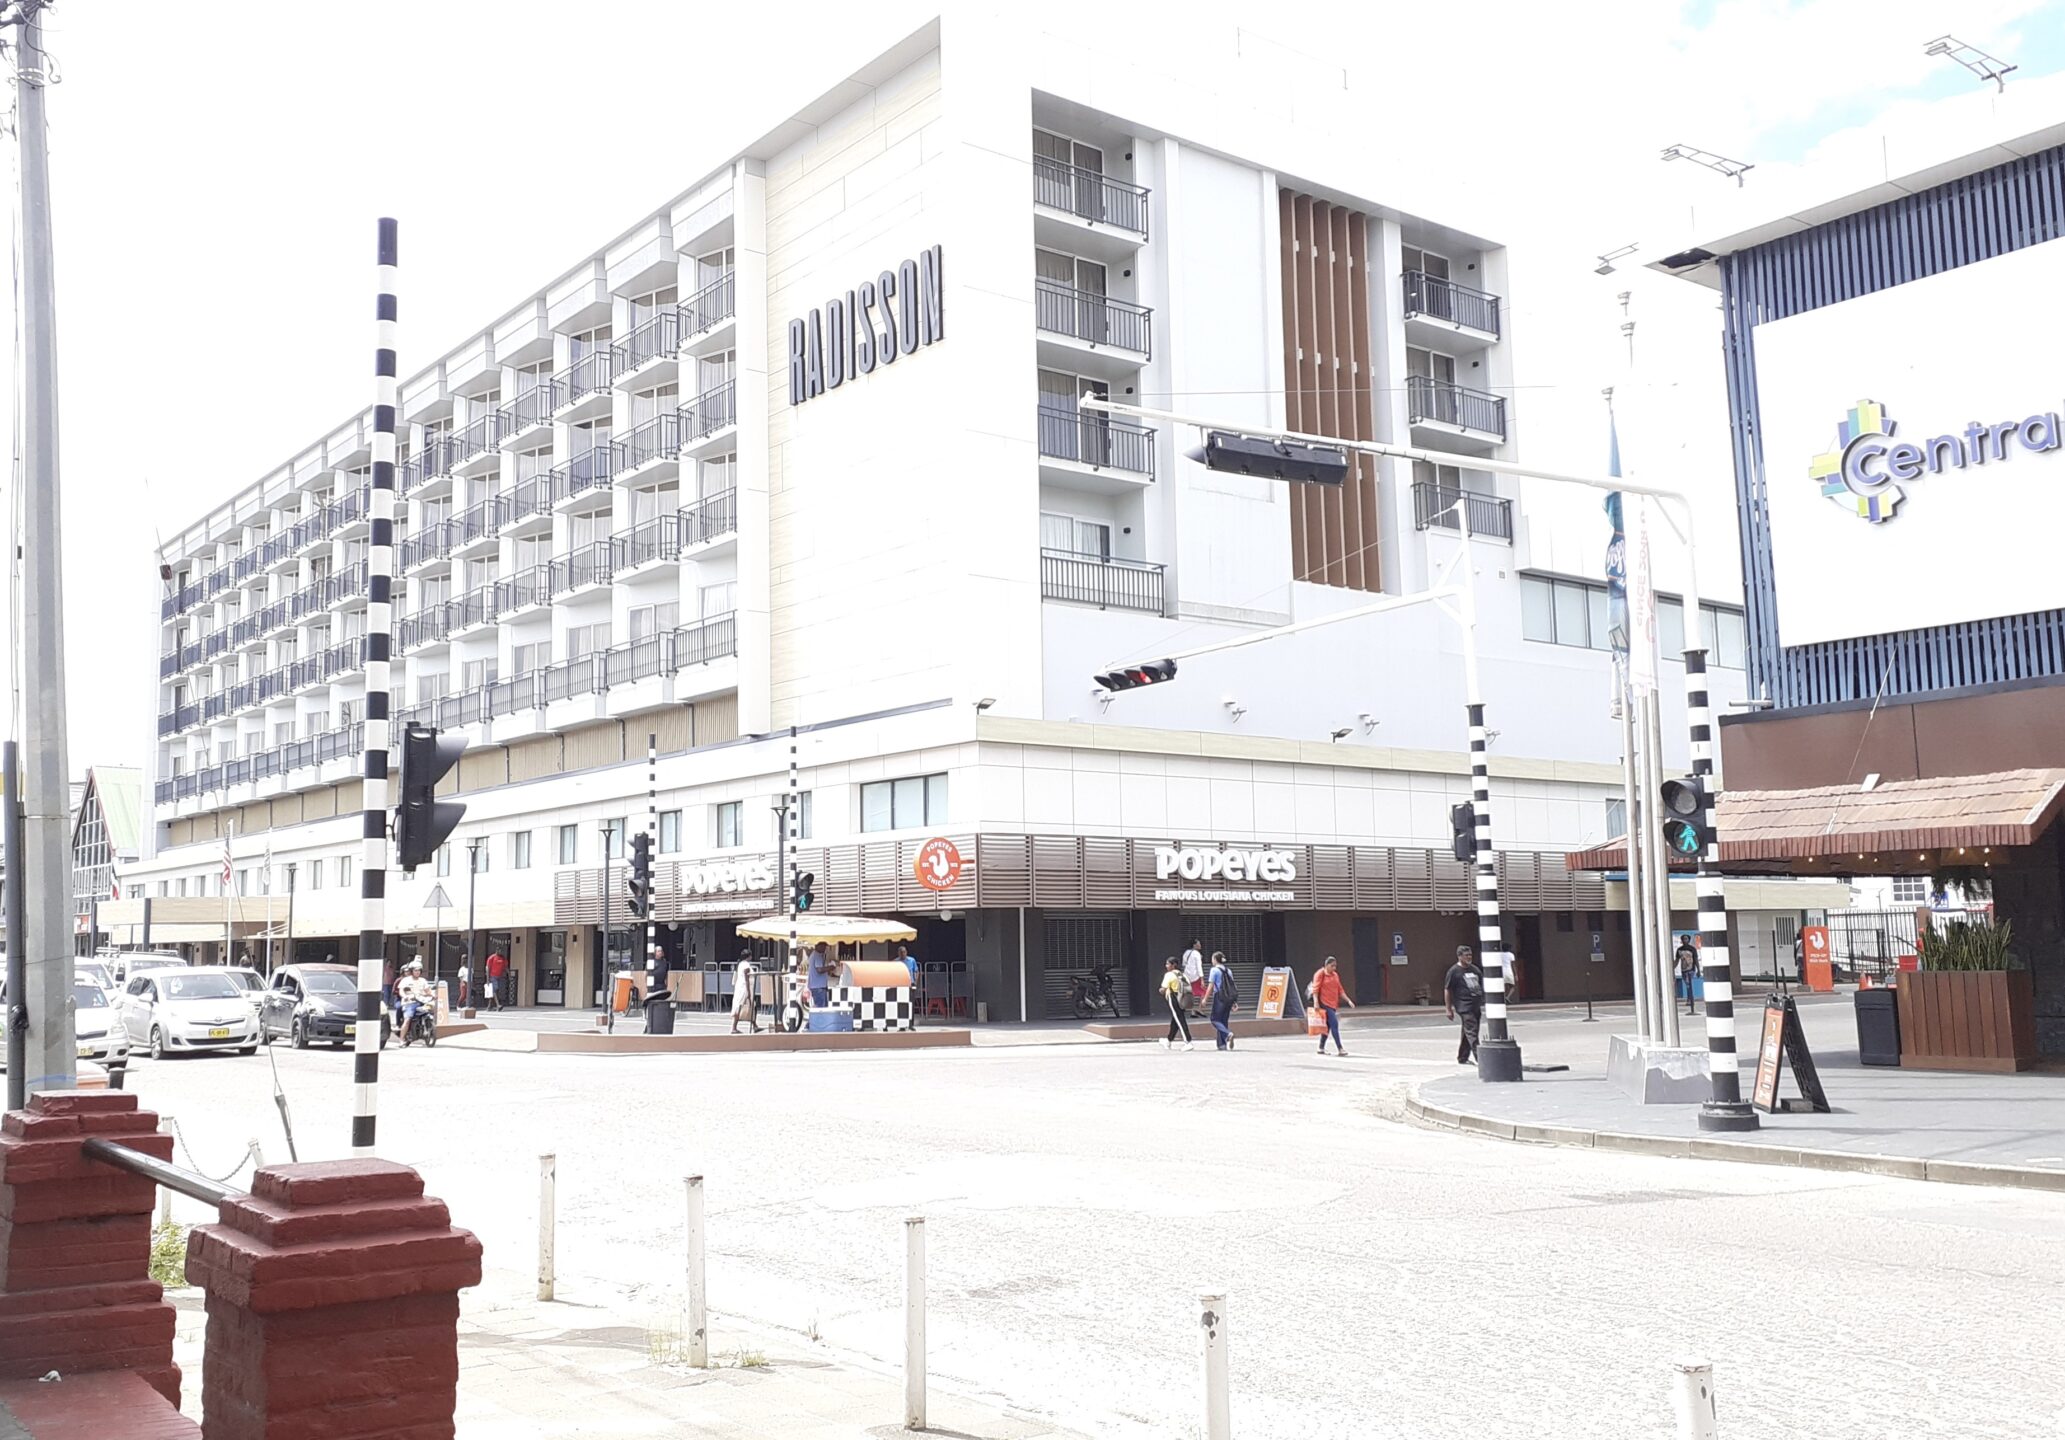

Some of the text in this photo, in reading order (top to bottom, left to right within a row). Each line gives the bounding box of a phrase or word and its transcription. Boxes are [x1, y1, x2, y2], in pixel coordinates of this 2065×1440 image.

[788, 243, 944, 406] RADISSON
[1851, 398, 2065, 487] Centra
[1154, 890, 1295, 901] FAMOUS LOUISIANA CHICKEN
[1394, 934, 1403, 950] P
[1593, 934, 1600, 948] P
